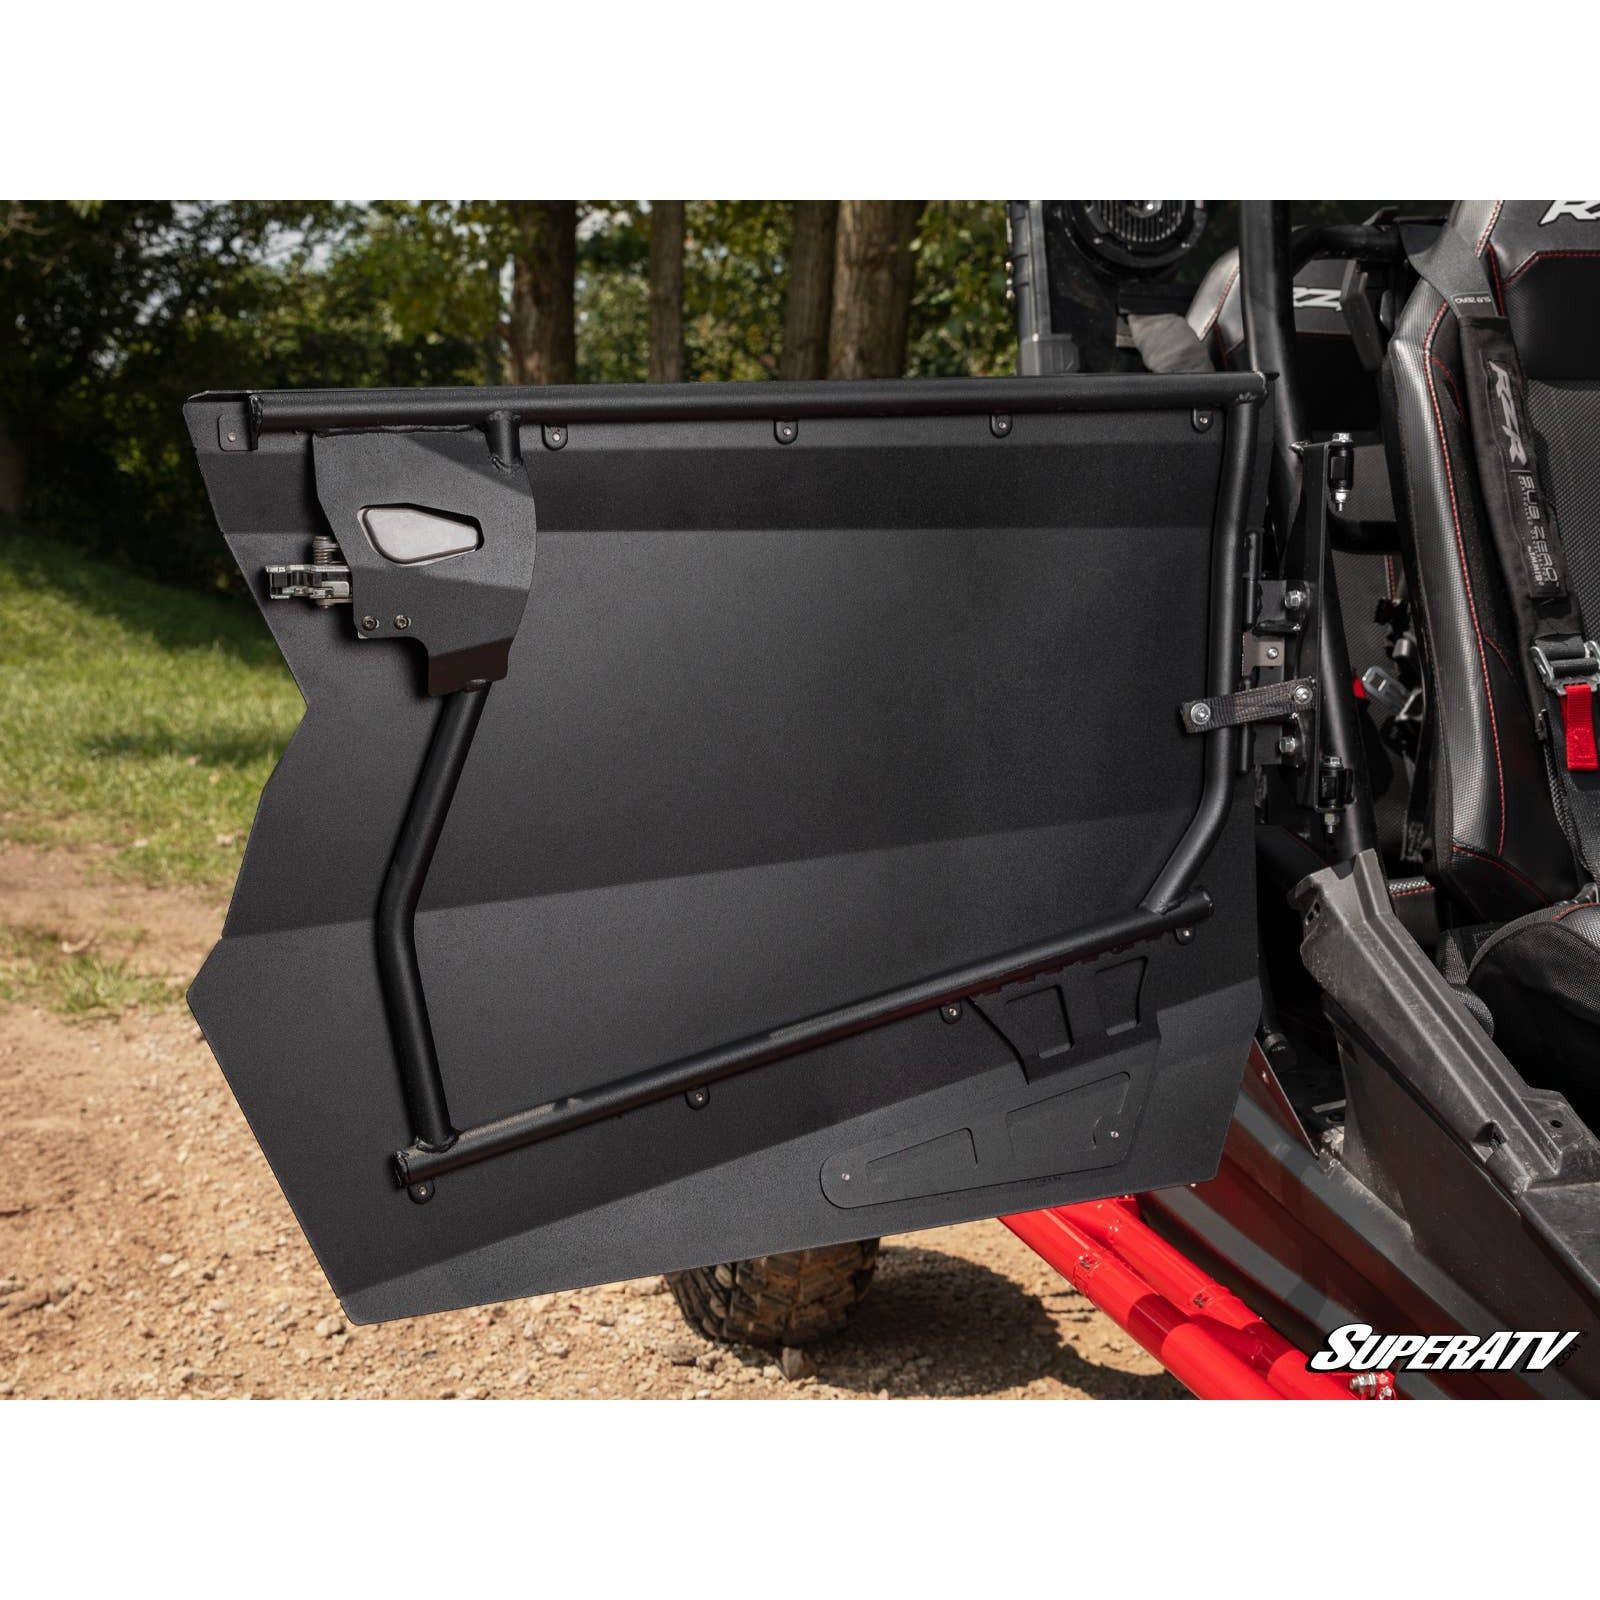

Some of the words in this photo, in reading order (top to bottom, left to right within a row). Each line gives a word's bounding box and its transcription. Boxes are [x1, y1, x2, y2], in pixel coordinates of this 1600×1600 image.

[1489, 361, 1527, 466] RZR
[1522, 475, 1540, 519] SUB
[1534, 526, 1558, 581] ZERO
